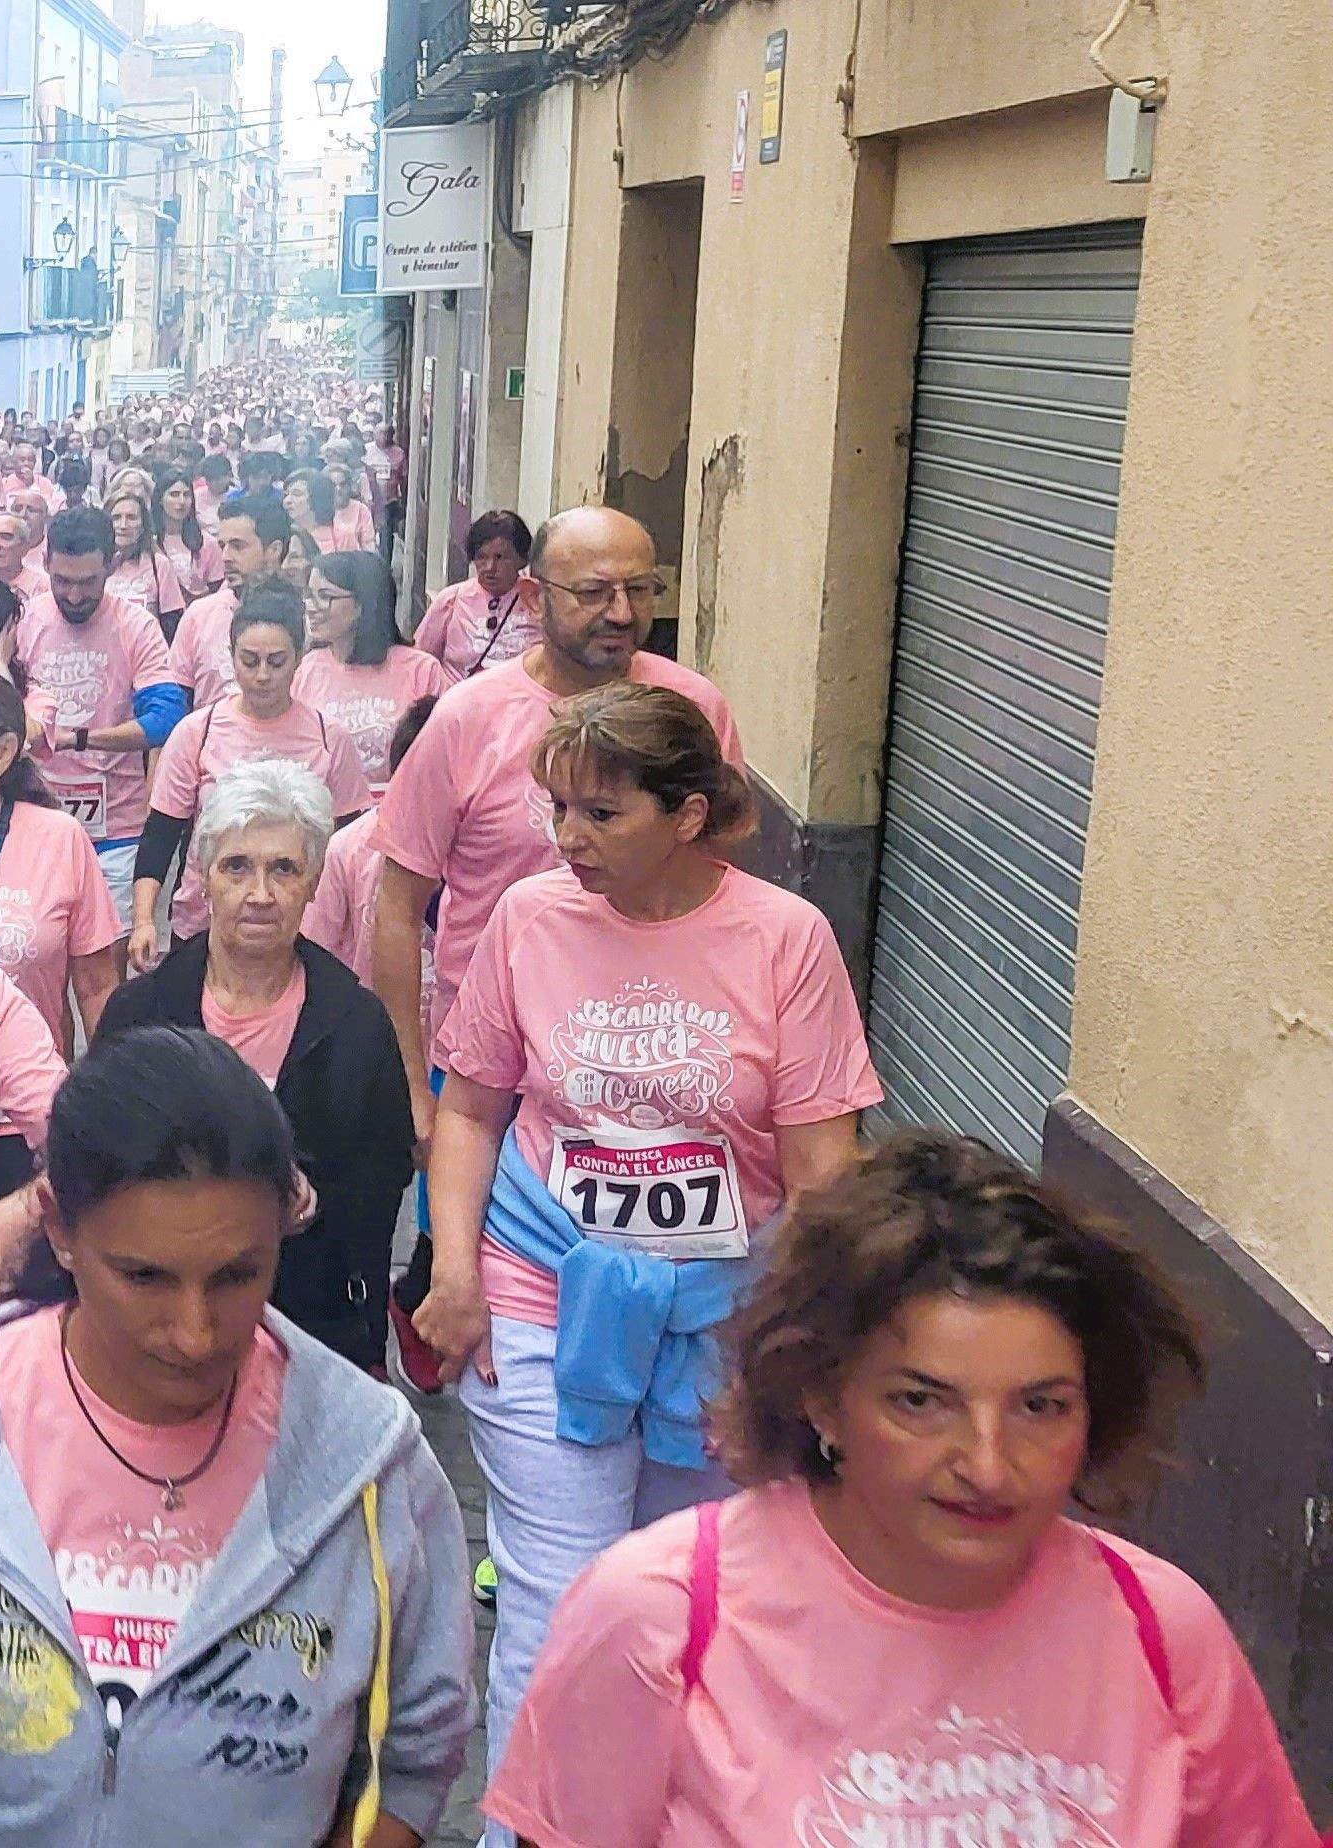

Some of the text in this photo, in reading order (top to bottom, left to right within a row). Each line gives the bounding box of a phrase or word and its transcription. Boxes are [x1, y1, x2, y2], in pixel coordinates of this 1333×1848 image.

[386, 161, 482, 217] Gala
[386, 240, 478, 257] Centro de estética
[402, 259, 460, 274] y bienestar
[611, 1000, 717, 1030] CARRERA
[580, 1022, 688, 1067] HUESCA
[573, 1153, 717, 1176] CONTRA EL CÁNCER
[616, 1149, 663, 1161] HUESCA
[570, 1175, 721, 1229] 1707
